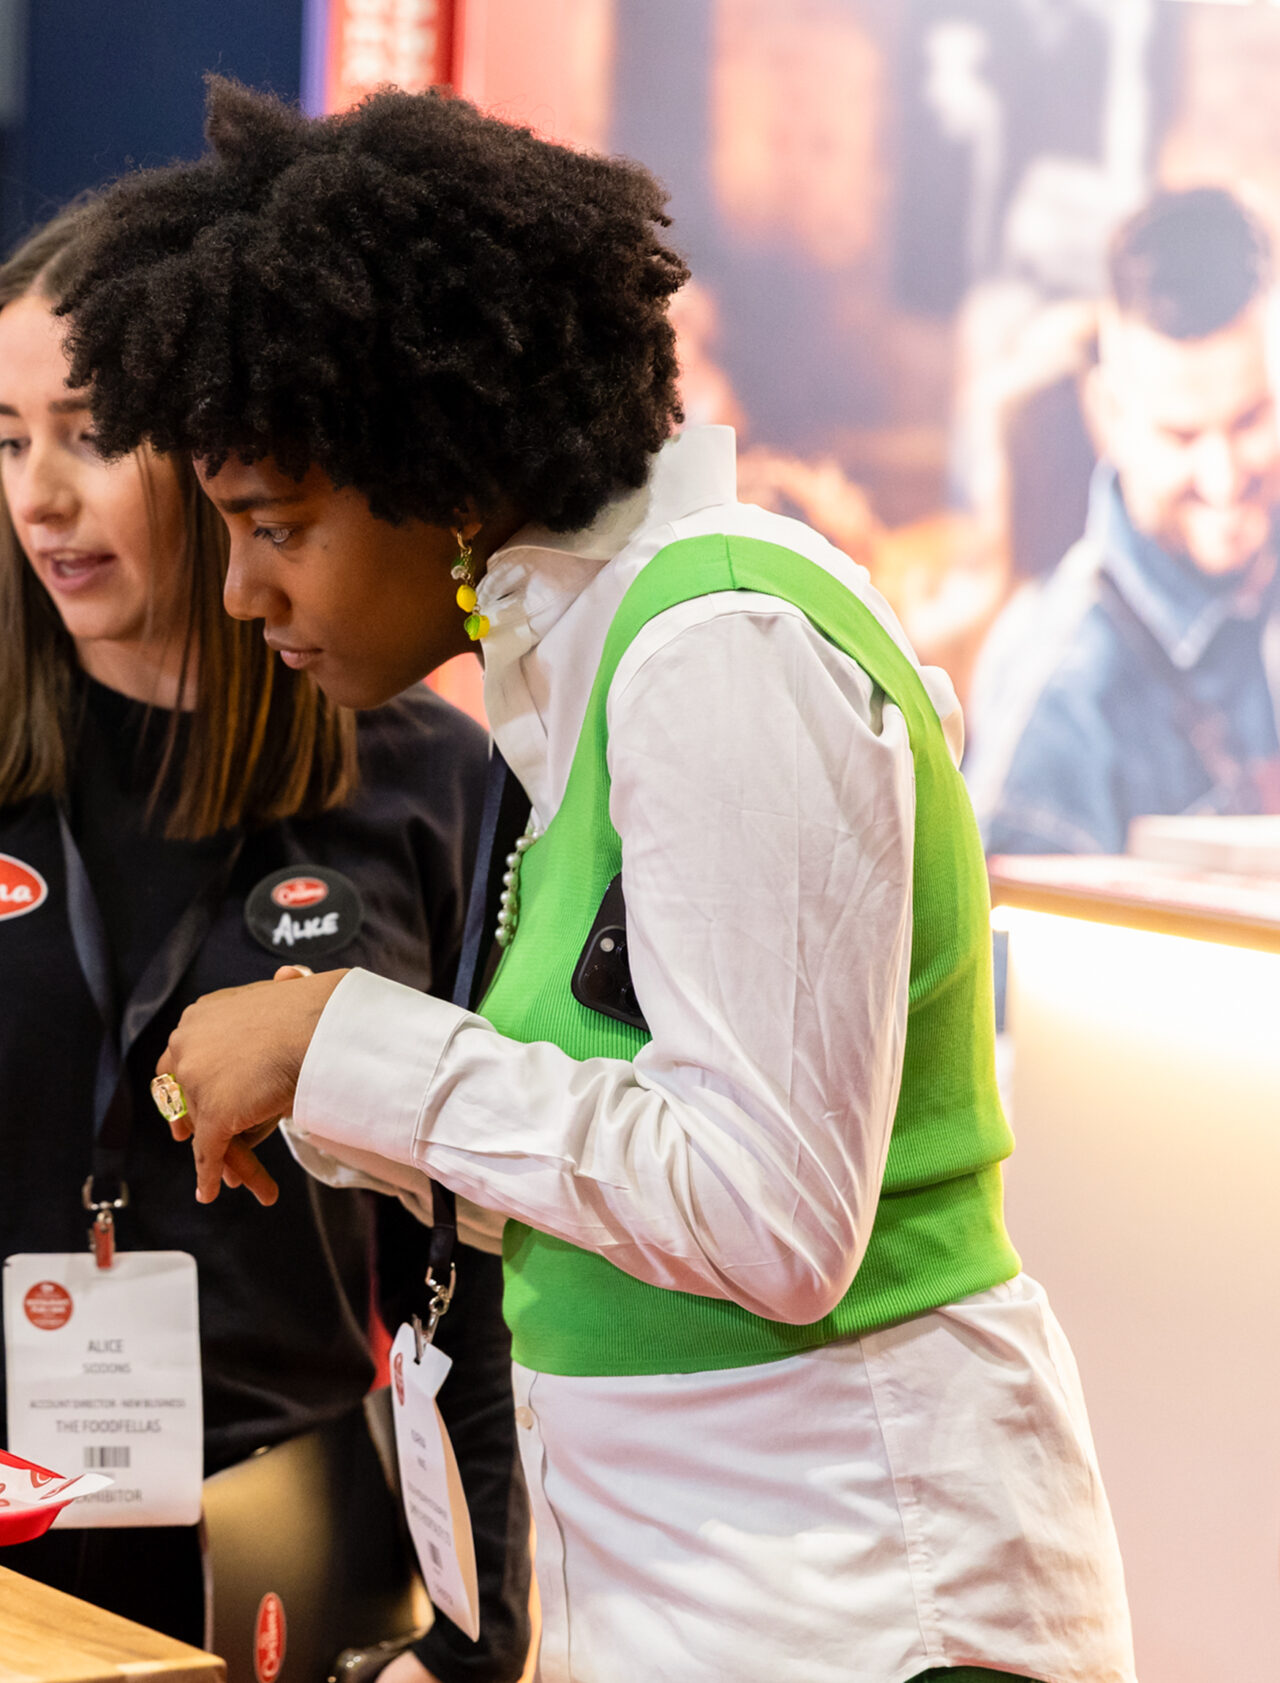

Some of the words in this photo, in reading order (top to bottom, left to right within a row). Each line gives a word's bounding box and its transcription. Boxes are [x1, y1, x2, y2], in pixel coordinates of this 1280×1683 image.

[87, 1339, 123, 1354] ALICE
[56, 1419, 79, 1433] THE
[82, 1419, 162, 1433] FOODFELLAS
